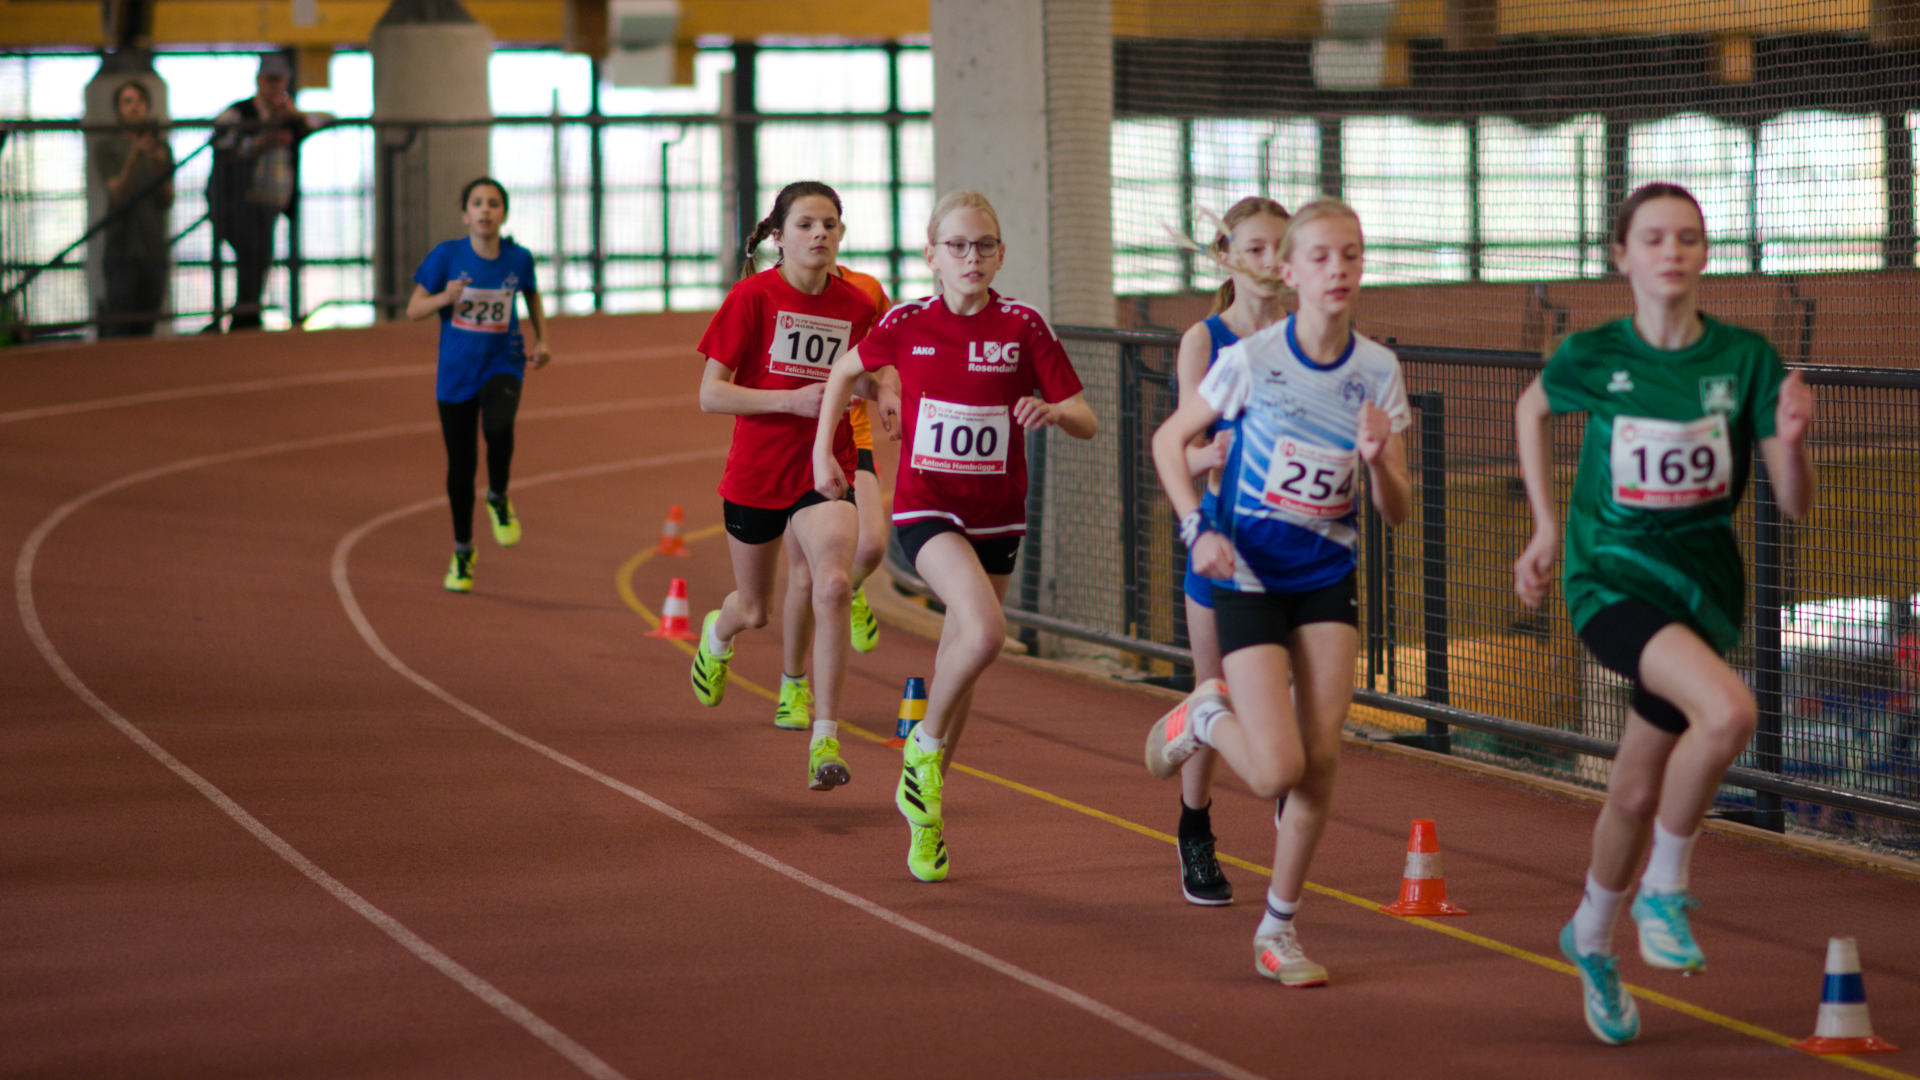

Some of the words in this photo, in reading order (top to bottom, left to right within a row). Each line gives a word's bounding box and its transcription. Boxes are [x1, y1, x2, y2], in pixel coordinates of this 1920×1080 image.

[459, 300, 505, 323] 228
[787, 331, 843, 366] 107
[911, 345, 936, 356] JAKO
[784, 364, 806, 375] Felicia
[967, 363, 1018, 373] Rosendahl
[930, 421, 998, 457] 100
[921, 457, 952, 469] Antonia
[1630, 444, 1717, 487] 169
[1280, 461, 1355, 501] 254
